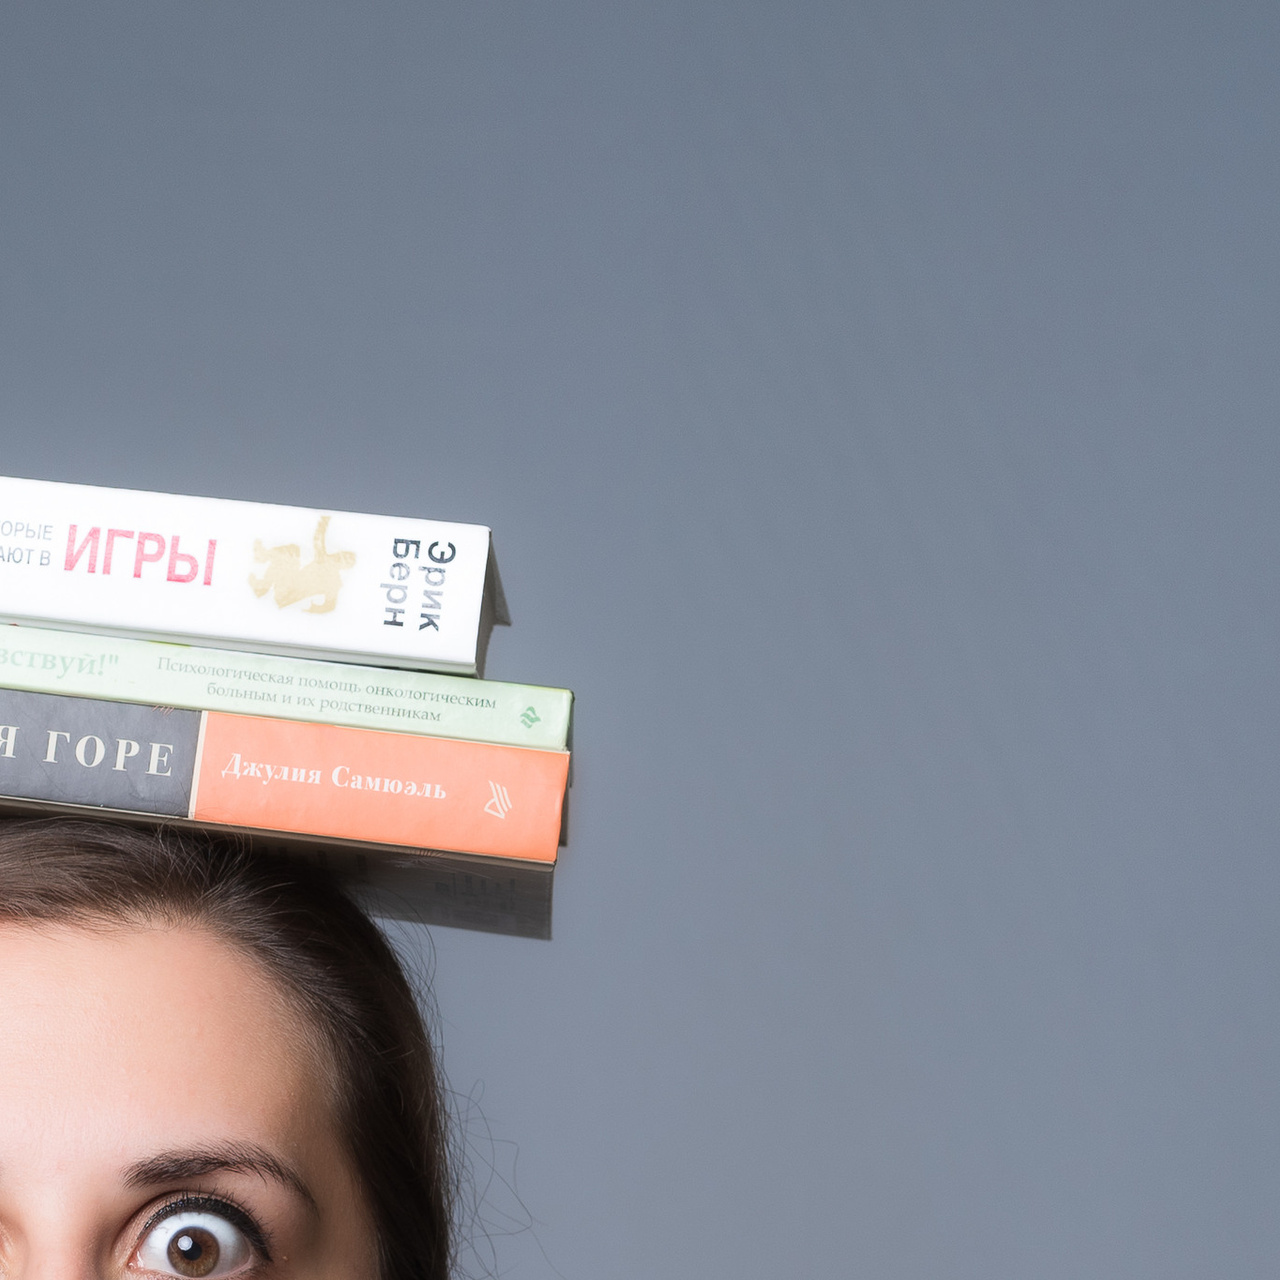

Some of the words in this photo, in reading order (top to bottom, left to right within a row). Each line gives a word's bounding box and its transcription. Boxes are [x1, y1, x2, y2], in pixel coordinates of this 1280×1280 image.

[39, 549, 51, 567] В
[64, 524, 217, 586] ИГРЫ
[380, 538, 421, 627] Берн
[418, 541, 456, 632] Эрик
[157, 656, 294, 686] Психологическая
[298, 677, 361, 694] помощь
[366, 684, 497, 709] онкологическим
[207, 682, 277, 703] больным
[282, 695, 292, 705] и
[296, 696, 315, 707] их
[319, 698, 442, 722] родственникам
[42, 730, 174, 777] ГОРЕ
[221, 752, 322, 785] Джулия
[331, 766, 447, 799] Самюэль
